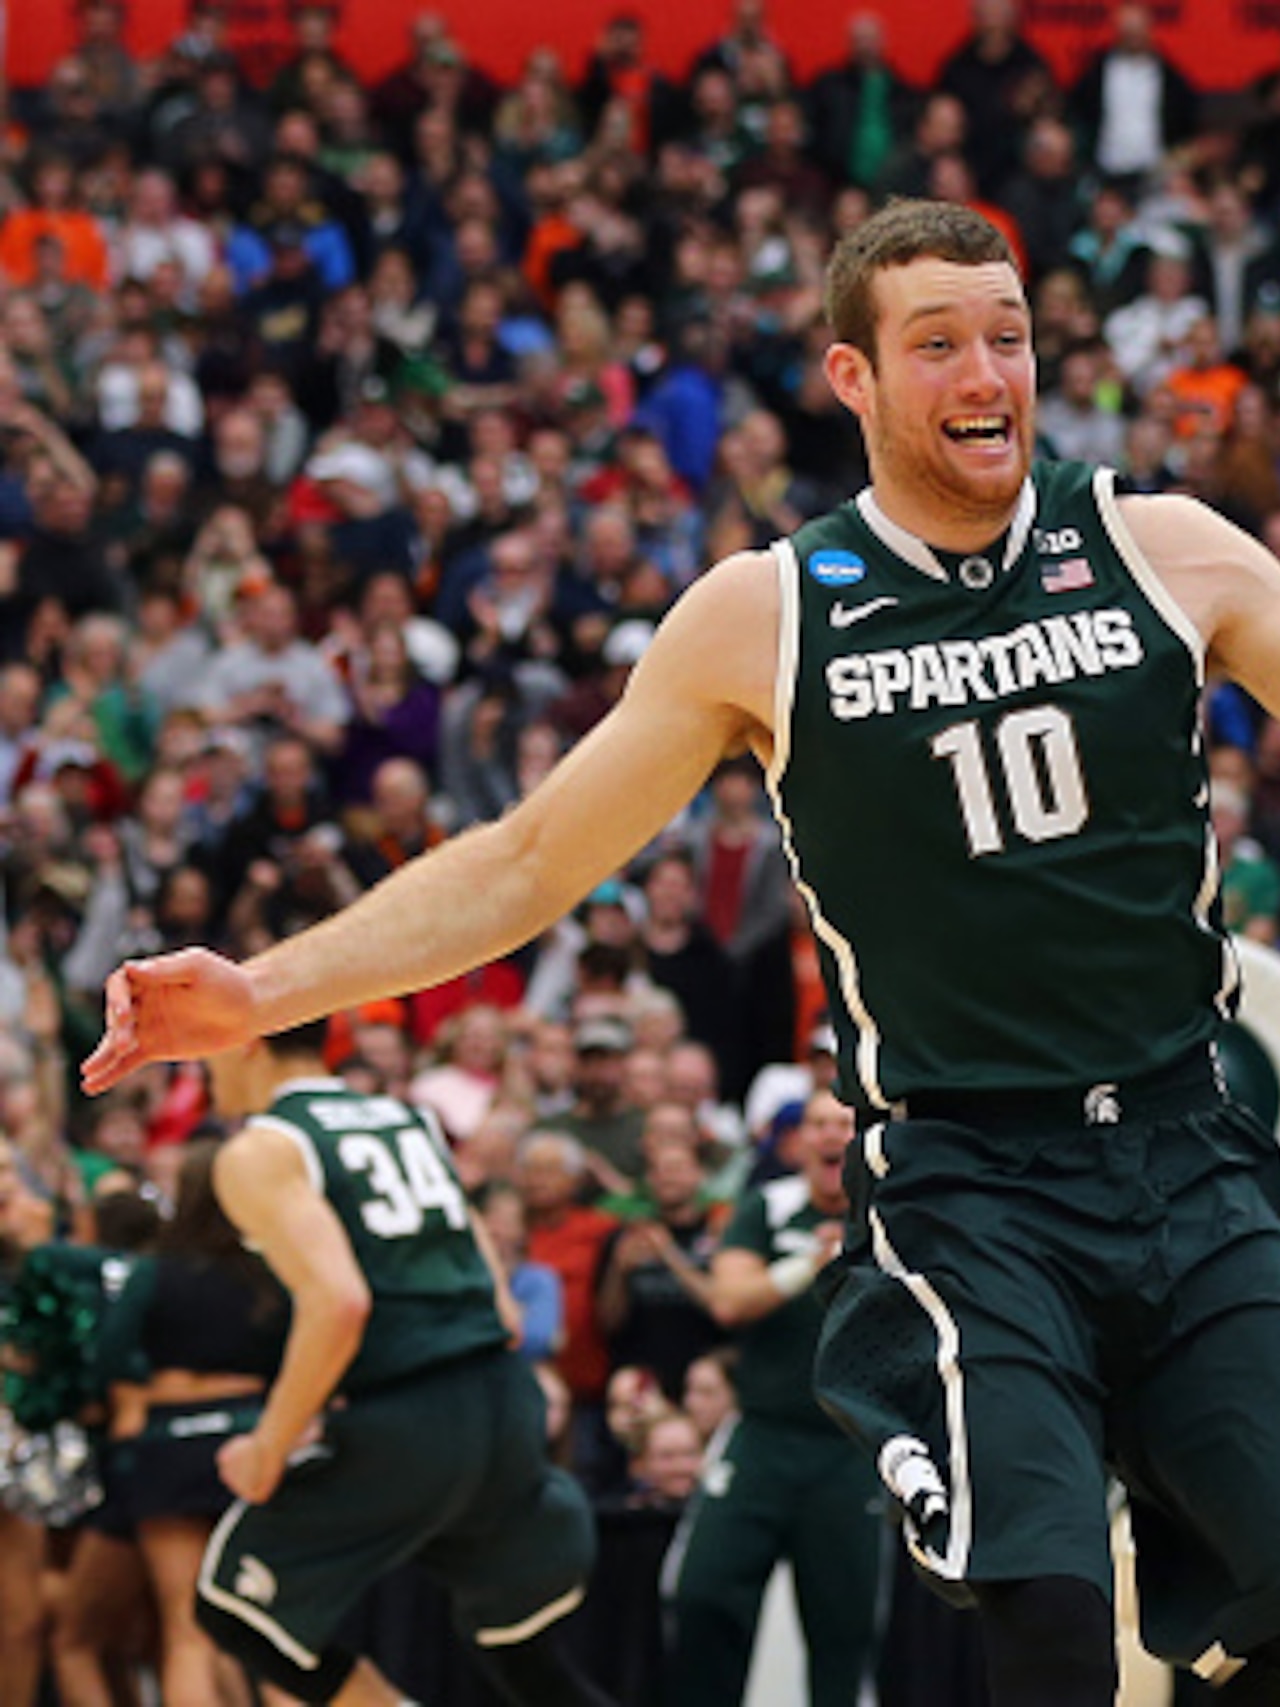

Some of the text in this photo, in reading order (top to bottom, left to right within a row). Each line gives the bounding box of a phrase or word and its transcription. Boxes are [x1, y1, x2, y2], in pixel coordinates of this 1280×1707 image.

[825, 607, 1144, 721] SPARTANS
[928, 704, 1089, 860] 10
[337, 1127, 469, 1239] 34
